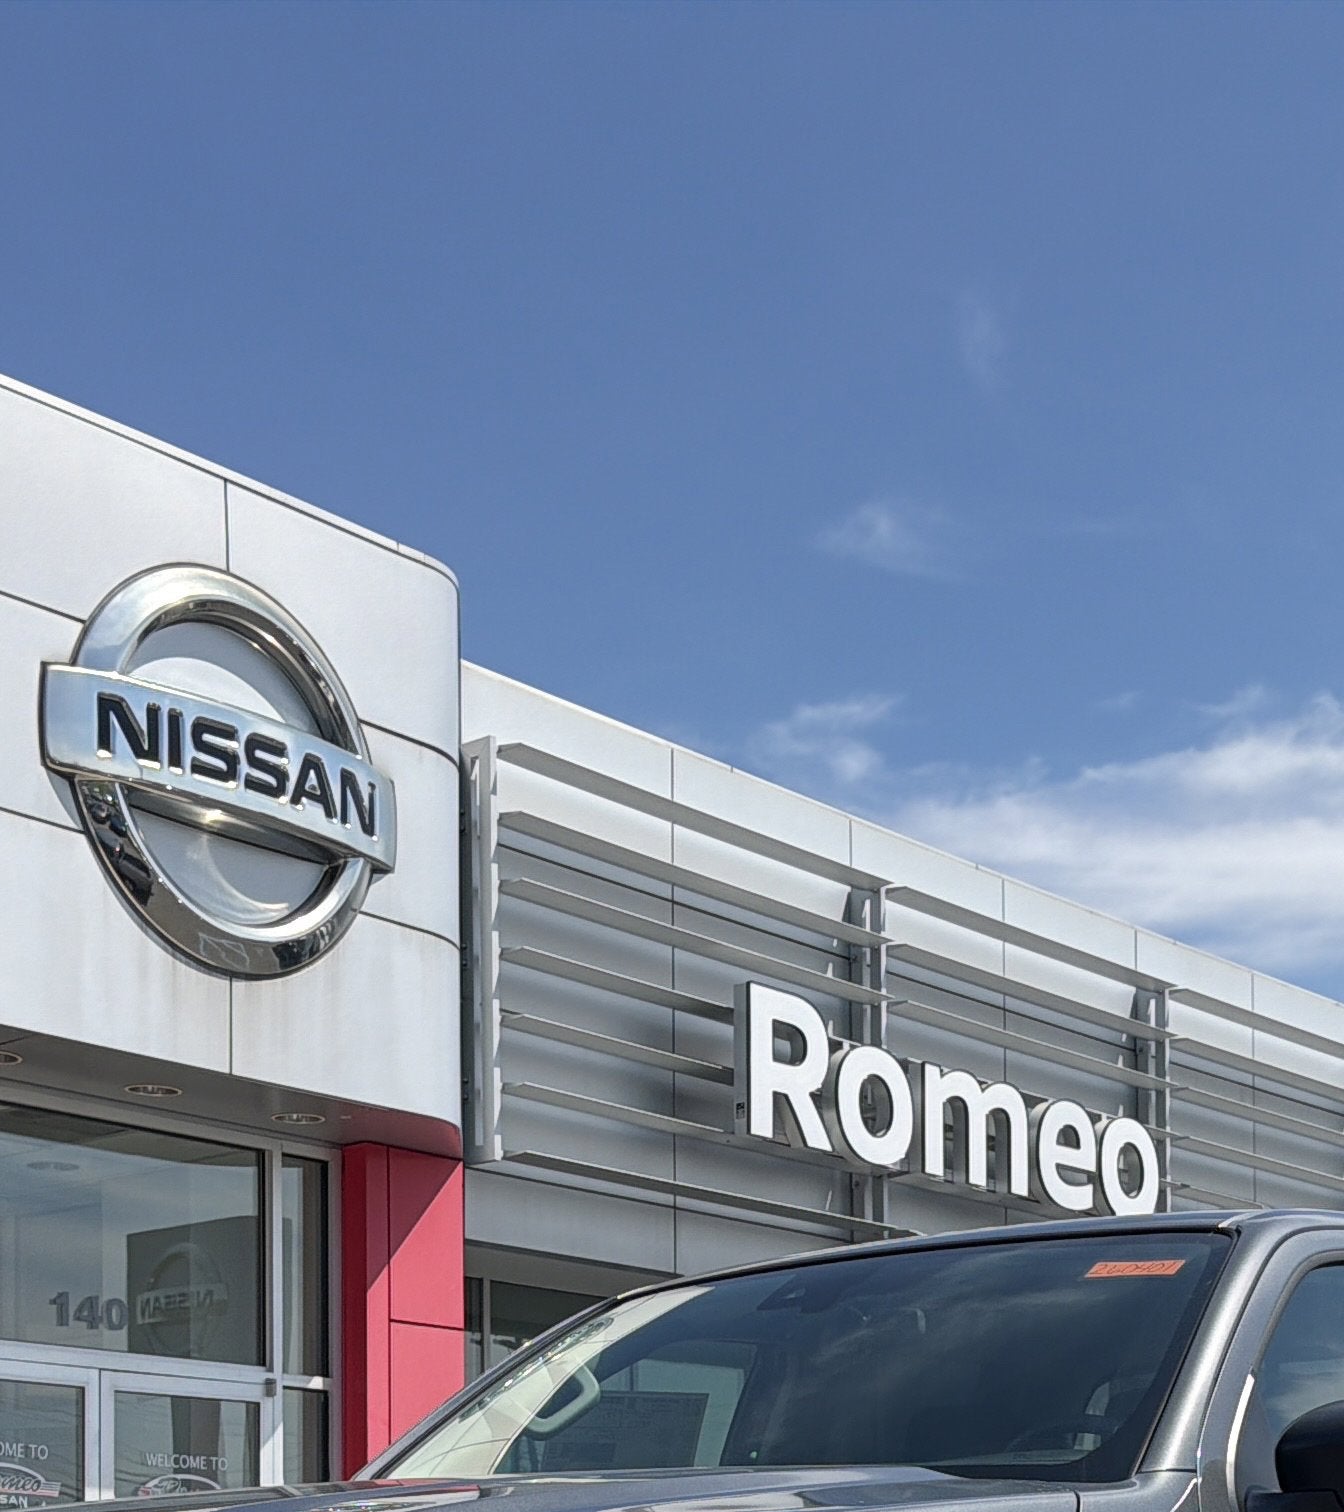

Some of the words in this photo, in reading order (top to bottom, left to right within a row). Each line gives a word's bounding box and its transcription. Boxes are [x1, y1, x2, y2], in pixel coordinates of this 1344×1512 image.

[96, 691, 377, 841] NISSAN
[740, 980, 1160, 1215] Romeo
[49, 1291, 129, 1331] 140
[29, 1443, 49, 1461] TO
[146, 1452, 208, 1470] WELCOME
[210, 1456, 229, 1472] TO
